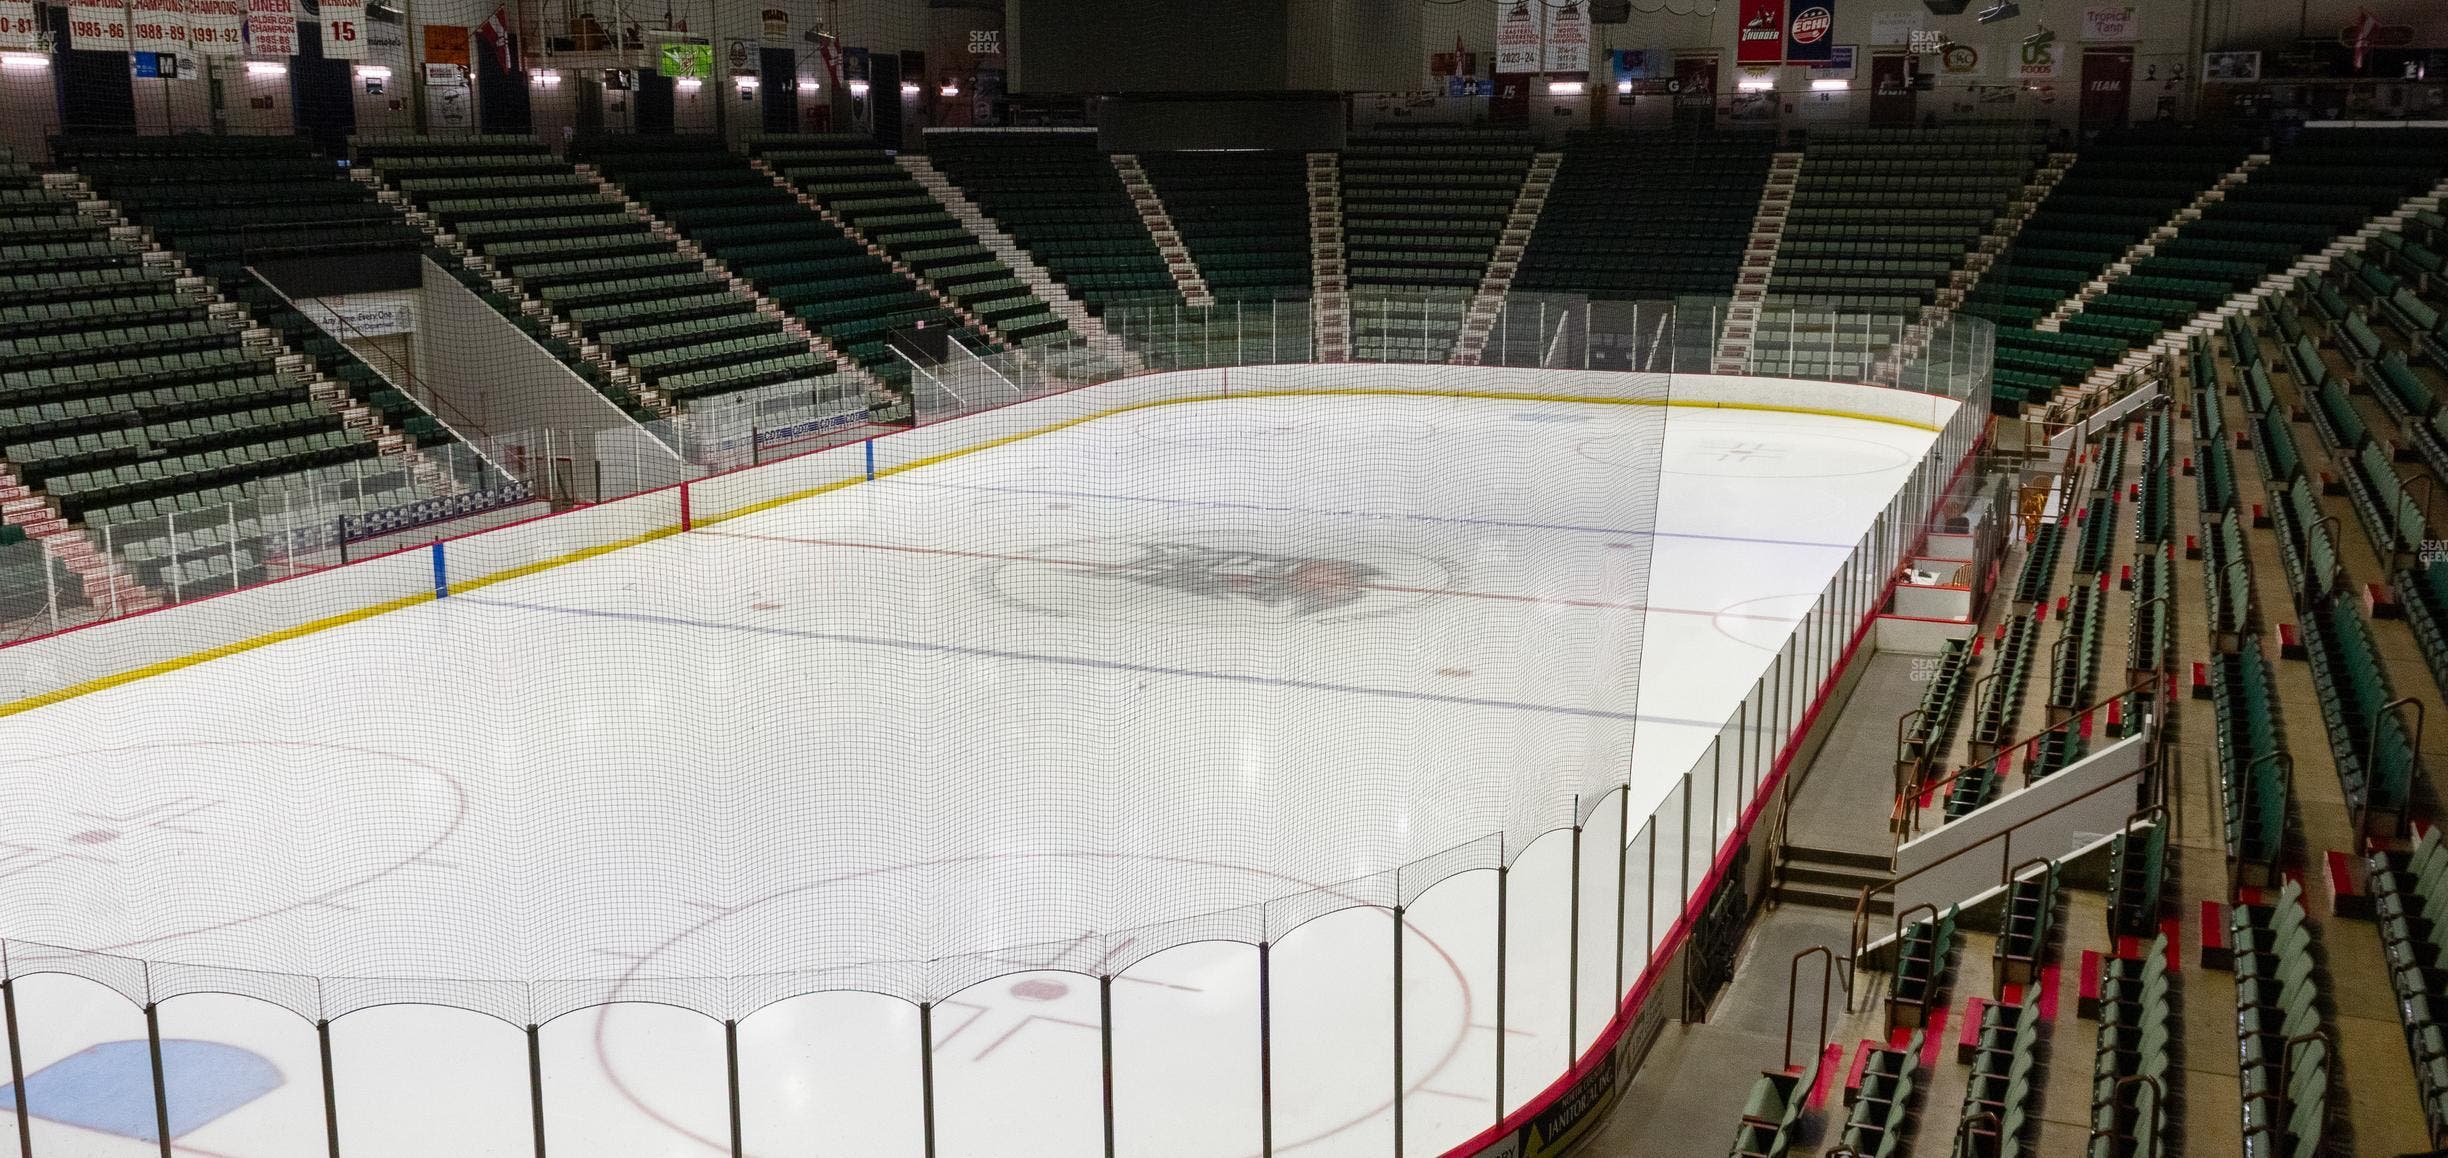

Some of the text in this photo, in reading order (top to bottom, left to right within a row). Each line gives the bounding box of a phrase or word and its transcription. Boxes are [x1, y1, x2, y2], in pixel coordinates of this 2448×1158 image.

[190, 0, 238, 15] CHAMPIONS
[70, 22, 124, 38] 1985-86
[250, 24, 295, 33] CHAMPION
[332, 21, 356, 41] 15
[1794, 17, 1829, 32] ECHL
[135, 24, 186, 41] 1988-89
[192, 27, 239, 43] 1991-92
[1742, 28, 1780, 41] THUNDER
[1501, 52, 1535, 63] 2023-24
[160, 57, 174, 74] M
[1668, 80, 1680, 92] G
